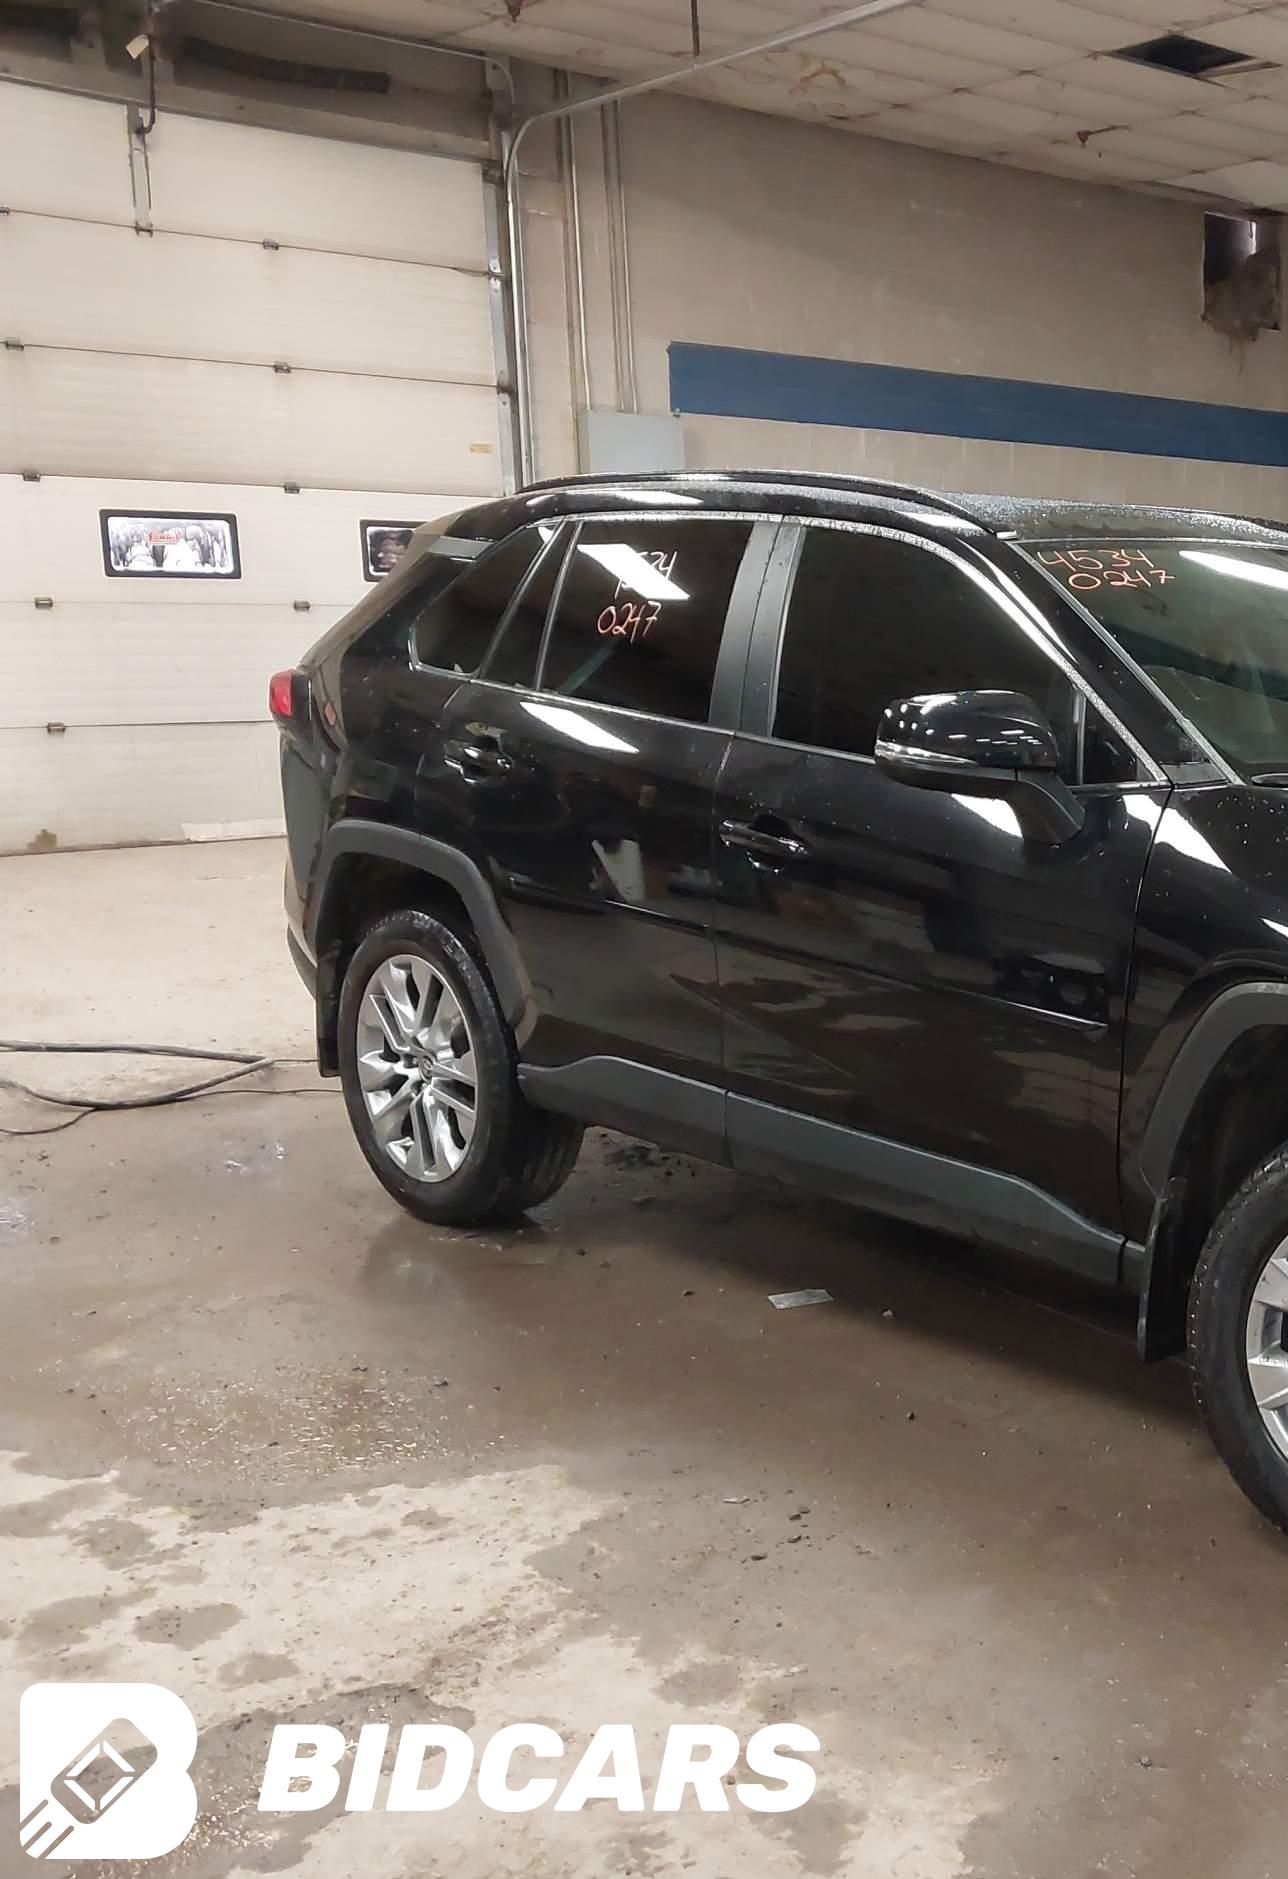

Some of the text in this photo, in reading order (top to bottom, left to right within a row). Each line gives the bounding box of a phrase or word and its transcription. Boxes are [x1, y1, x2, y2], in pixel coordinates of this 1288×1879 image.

[1036, 549, 1155, 573] 4534
[1067, 569, 1176, 590] 0247
[597, 600, 662, 644] 0247
